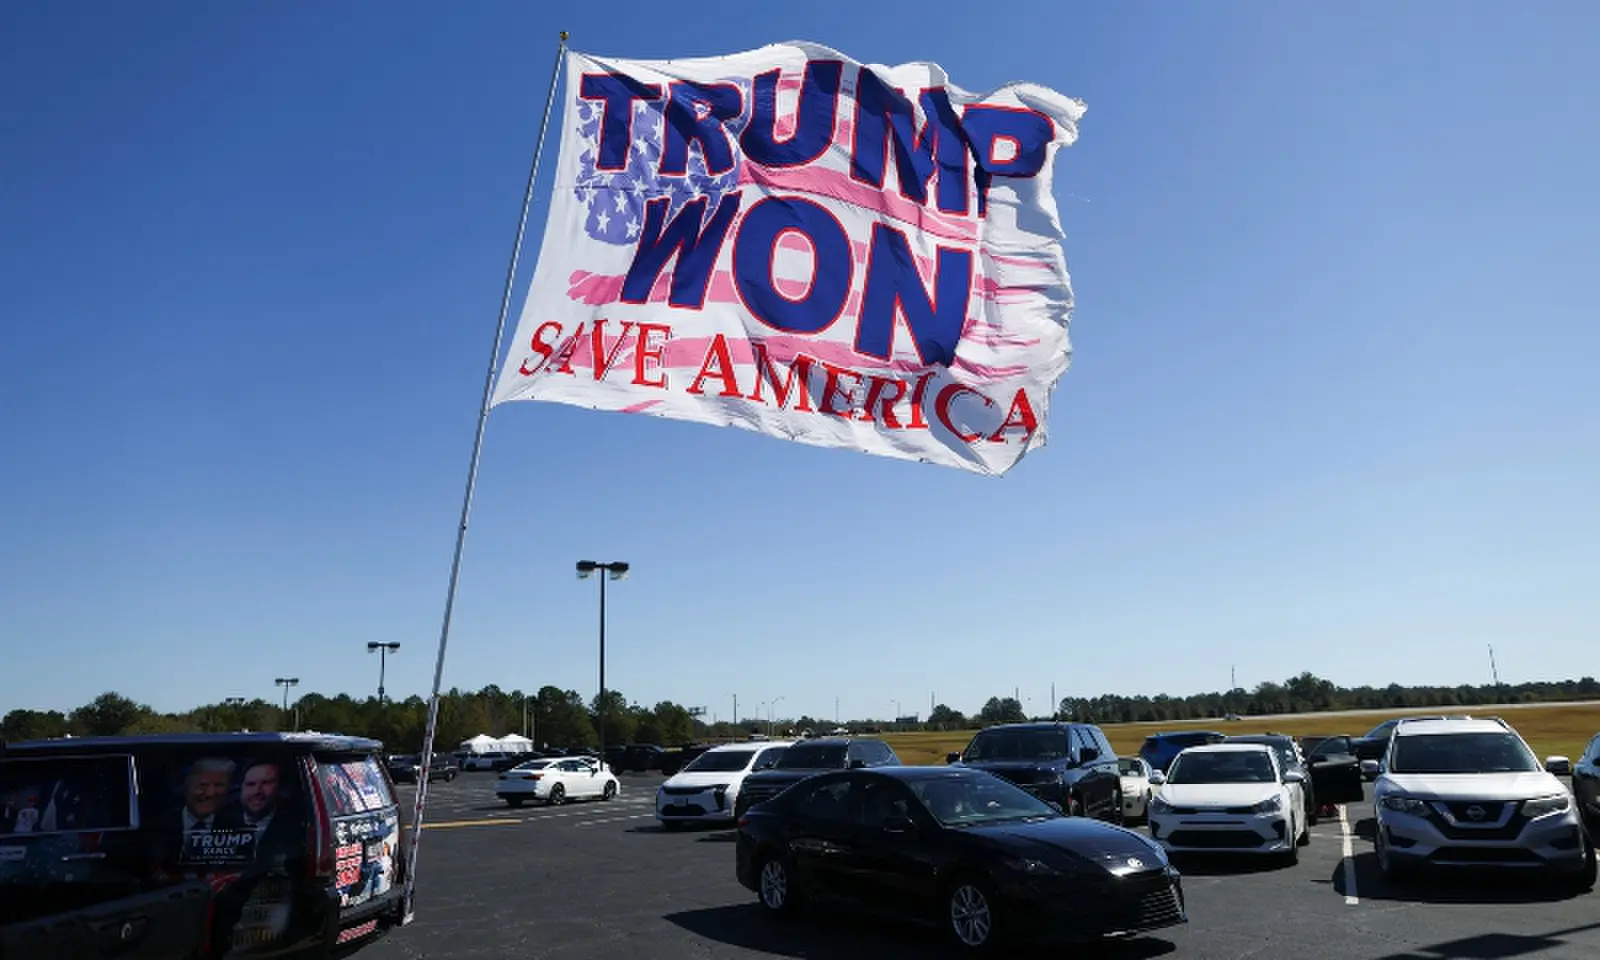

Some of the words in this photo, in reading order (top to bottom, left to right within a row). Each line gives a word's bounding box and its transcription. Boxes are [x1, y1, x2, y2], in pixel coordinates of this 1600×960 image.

[579, 59, 1056, 219] TRUMP
[619, 190, 975, 367] WON
[519, 318, 673, 387] SAVE
[686, 333, 1040, 443] AMERICA
[191, 833, 253, 847] TRUMP
